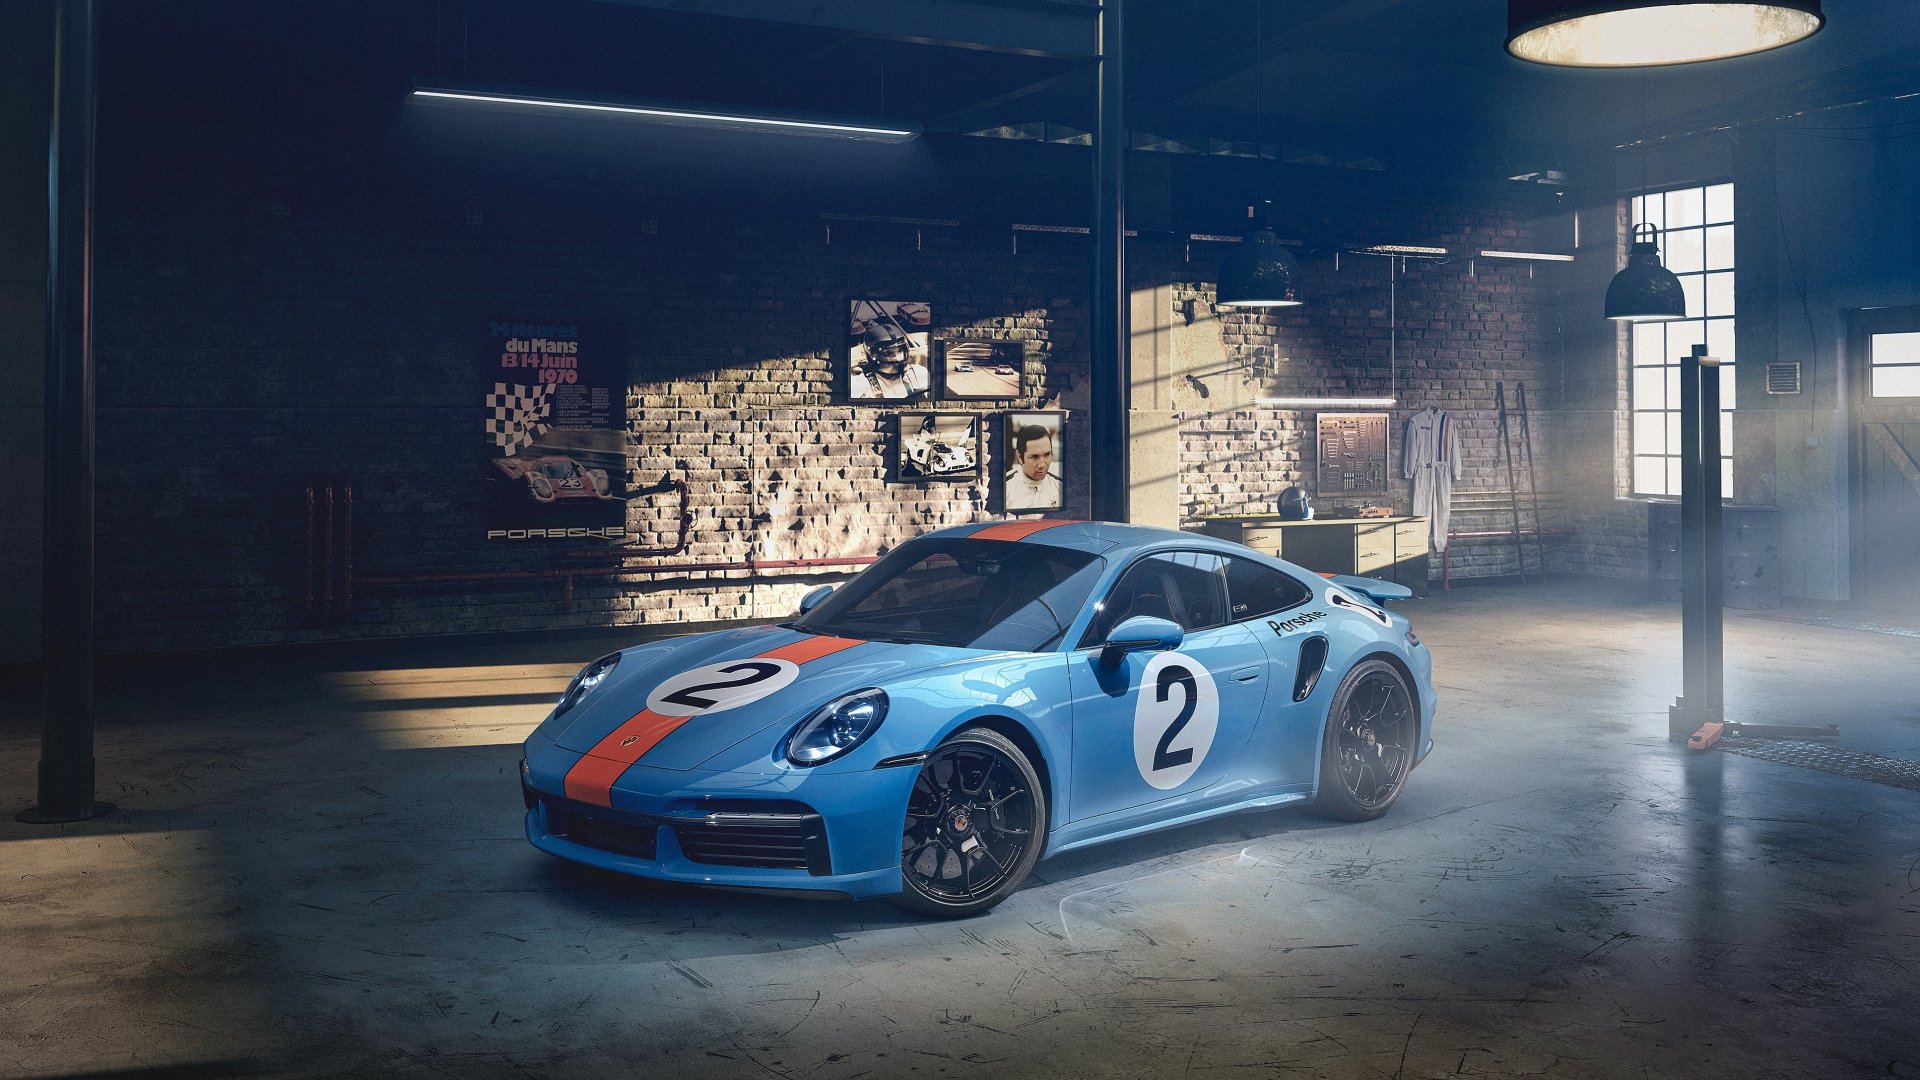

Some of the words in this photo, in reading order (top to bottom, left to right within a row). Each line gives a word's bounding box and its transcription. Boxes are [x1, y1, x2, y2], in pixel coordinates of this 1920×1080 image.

[488, 320, 510, 337] 24
[512, 321, 577, 338] Heures
[506, 338, 529, 353] du
[531, 338, 578, 353] Mans
[502, 352, 540, 368] 13/14
[540, 353, 577, 368] Juin
[538, 368, 577, 384] 1970
[560, 479, 581, 488] 23
[488, 526, 624, 540] PORSCHE
[1332, 594, 1387, 624] 2
[1267, 611, 1327, 637] Porsche
[659, 662, 782, 709] 2
[1152, 665, 1198, 771] 2
